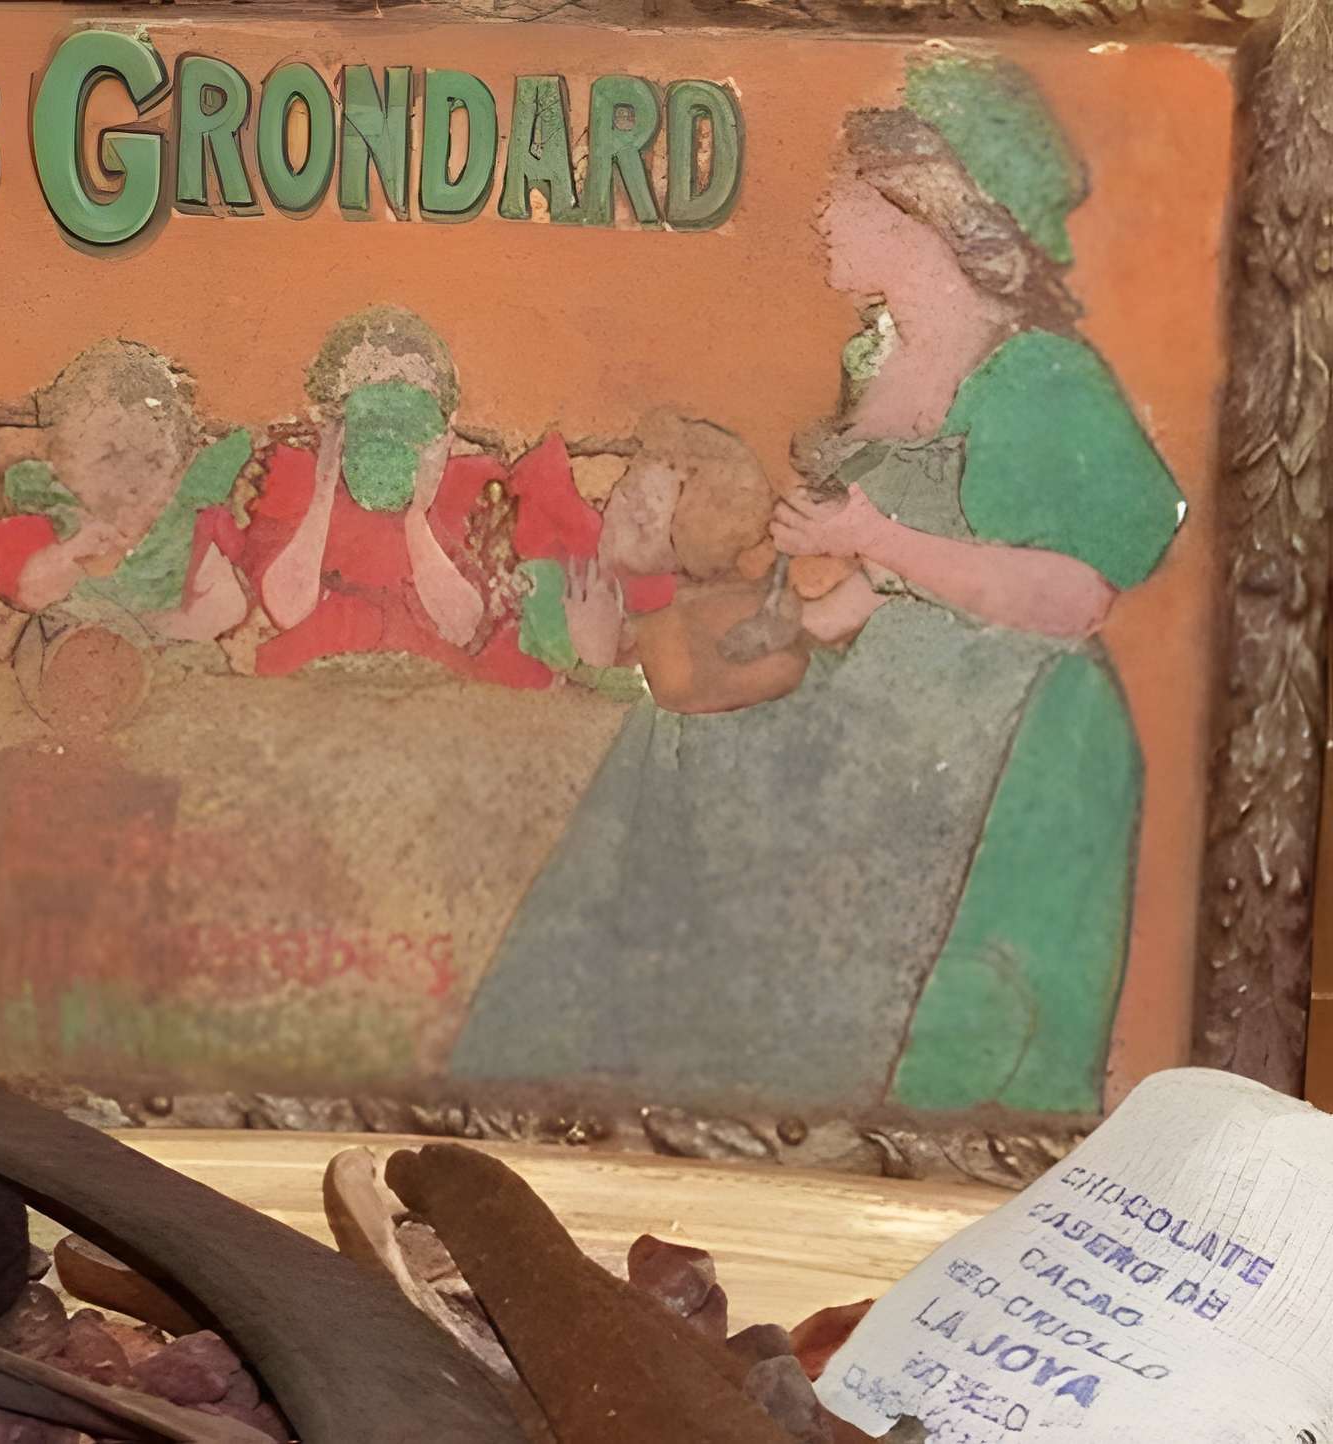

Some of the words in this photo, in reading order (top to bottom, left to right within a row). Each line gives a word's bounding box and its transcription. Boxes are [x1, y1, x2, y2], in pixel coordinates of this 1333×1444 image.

[30, 28, 746, 260] GRONDARD
[1019, 1247, 1144, 1328] CACAO
[912, 1296, 963, 1338] LA
[964, 1334, 1101, 1408] JOYA
